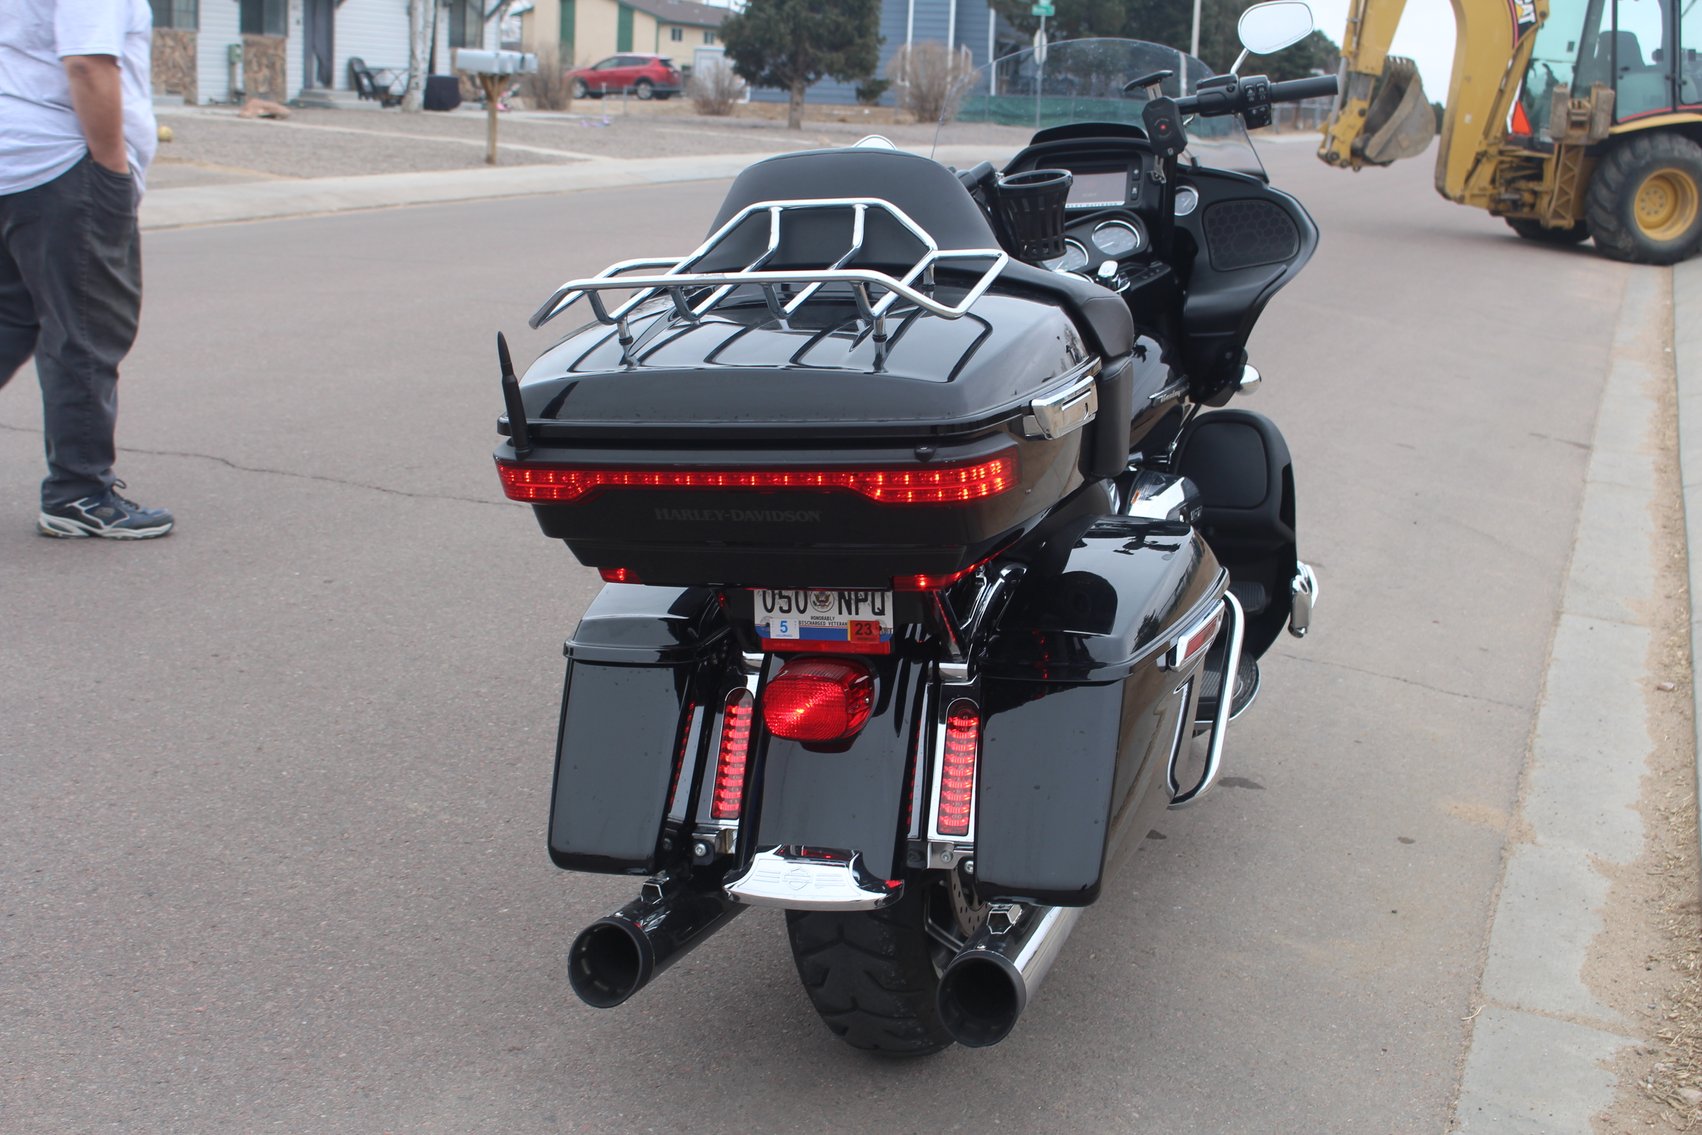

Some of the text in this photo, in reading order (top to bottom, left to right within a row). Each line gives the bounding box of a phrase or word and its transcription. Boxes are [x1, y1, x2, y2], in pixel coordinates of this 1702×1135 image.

[654, 508, 823, 522] HARLEY-DAVIDSON
[838, 591, 885, 616] NPQ
[779, 620, 788, 633] 5
[855, 622, 873, 636] 23
